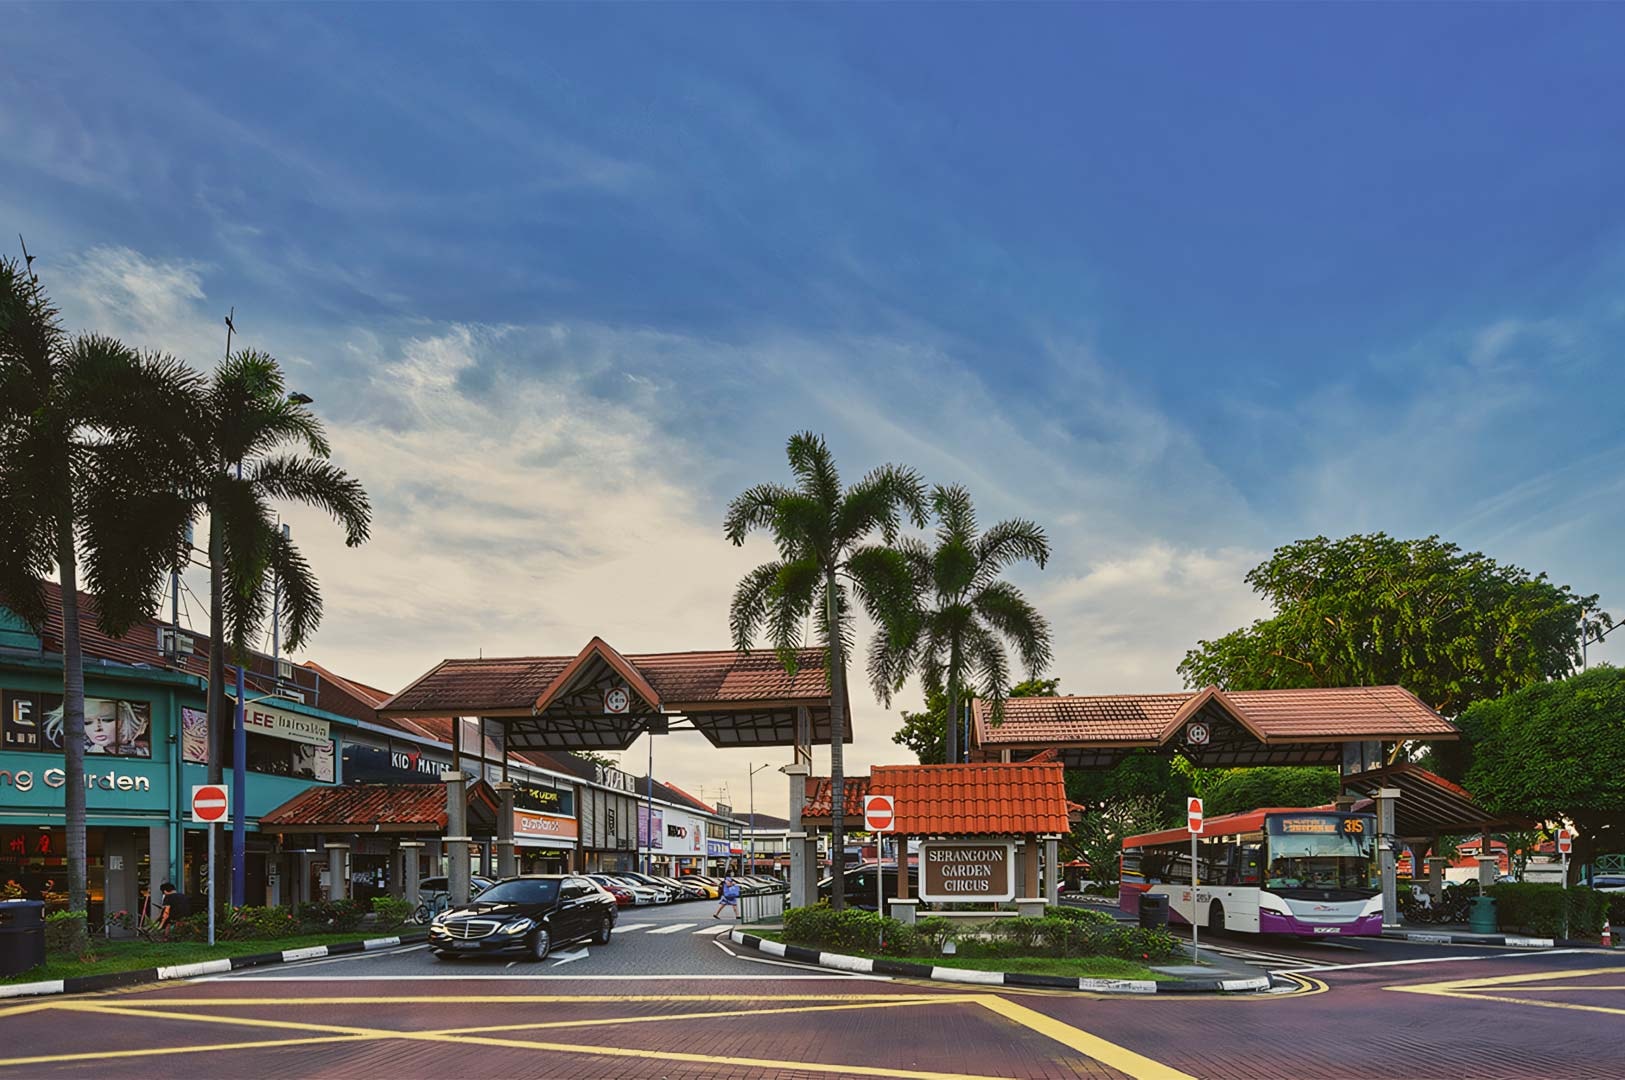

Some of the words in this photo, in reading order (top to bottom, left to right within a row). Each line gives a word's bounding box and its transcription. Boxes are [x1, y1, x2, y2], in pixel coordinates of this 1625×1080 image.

[243, 709, 275, 729] LEE
[43, 767, 151, 791] Grden
[1343, 819, 1364, 833] 315
[929, 850, 1003, 862] SERANGOON
[941, 864, 991, 877] GARDEN
[943, 879, 990, 892] CIRCUS
